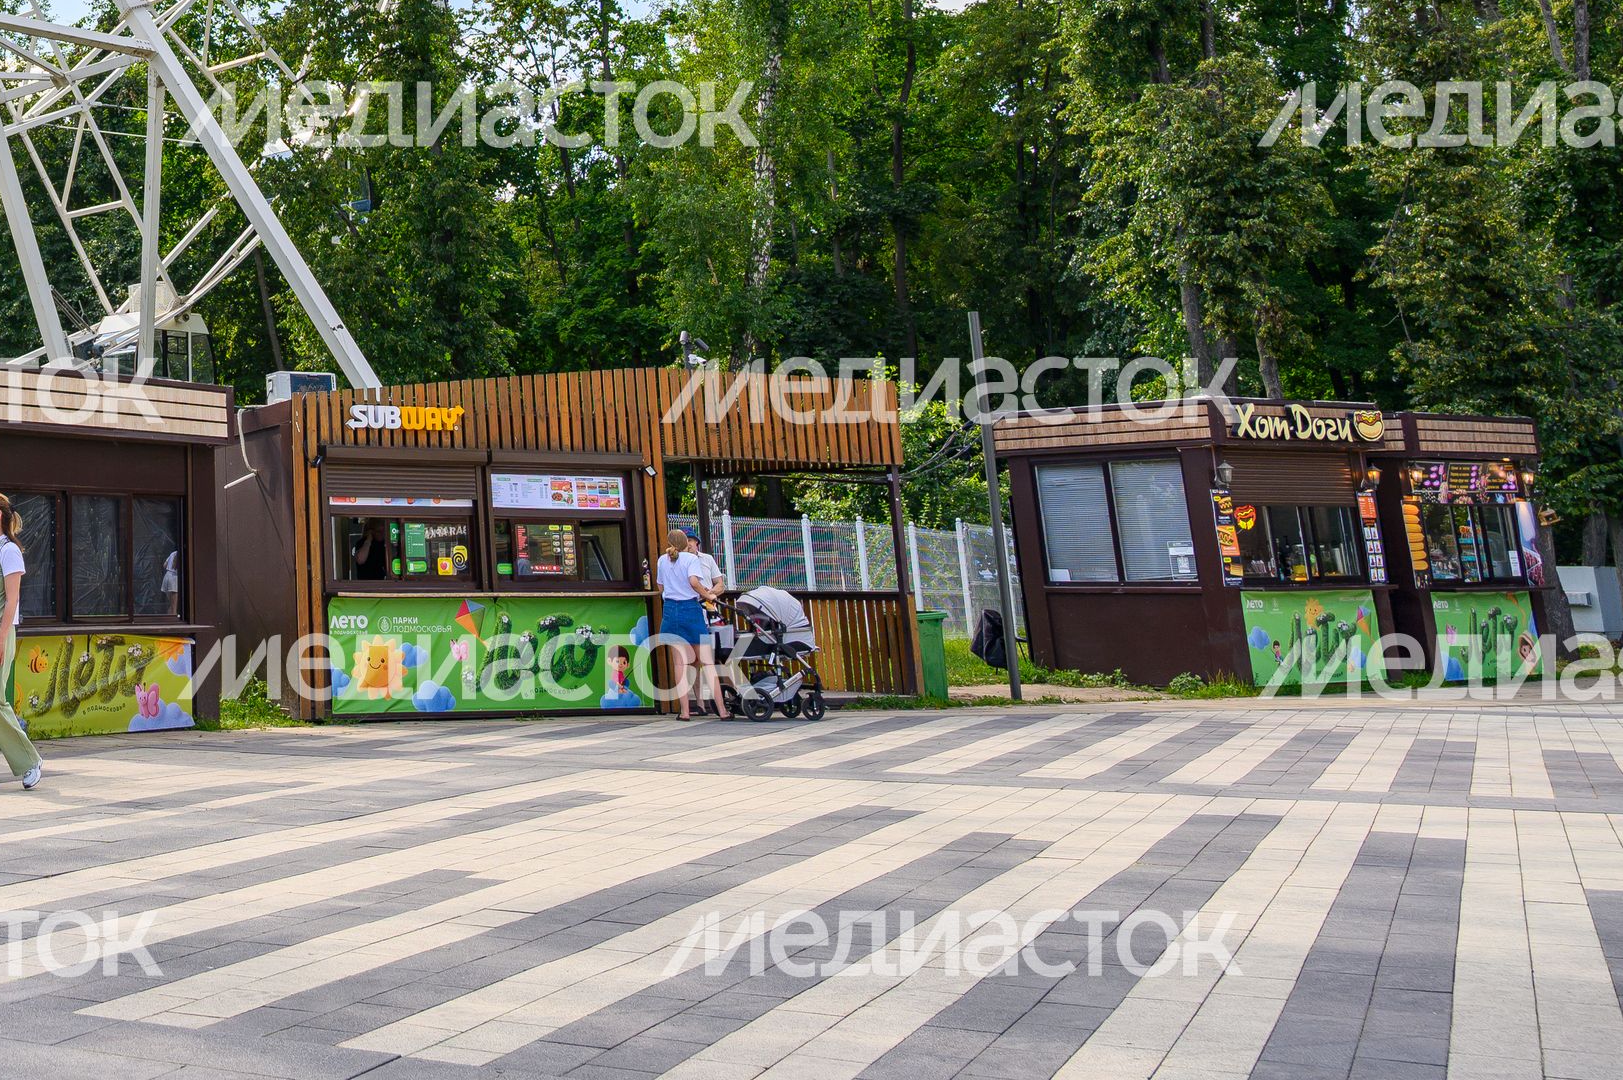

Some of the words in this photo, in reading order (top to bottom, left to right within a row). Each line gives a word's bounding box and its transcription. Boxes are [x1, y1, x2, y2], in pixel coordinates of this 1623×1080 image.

[347, 404, 464, 432] SUBWAY
[1234, 403, 1354, 443] Хот-Доги
[392, 617, 419, 625] ПАРКИ
[392, 624, 452, 634] ПОДМОСКОВЬЯ
